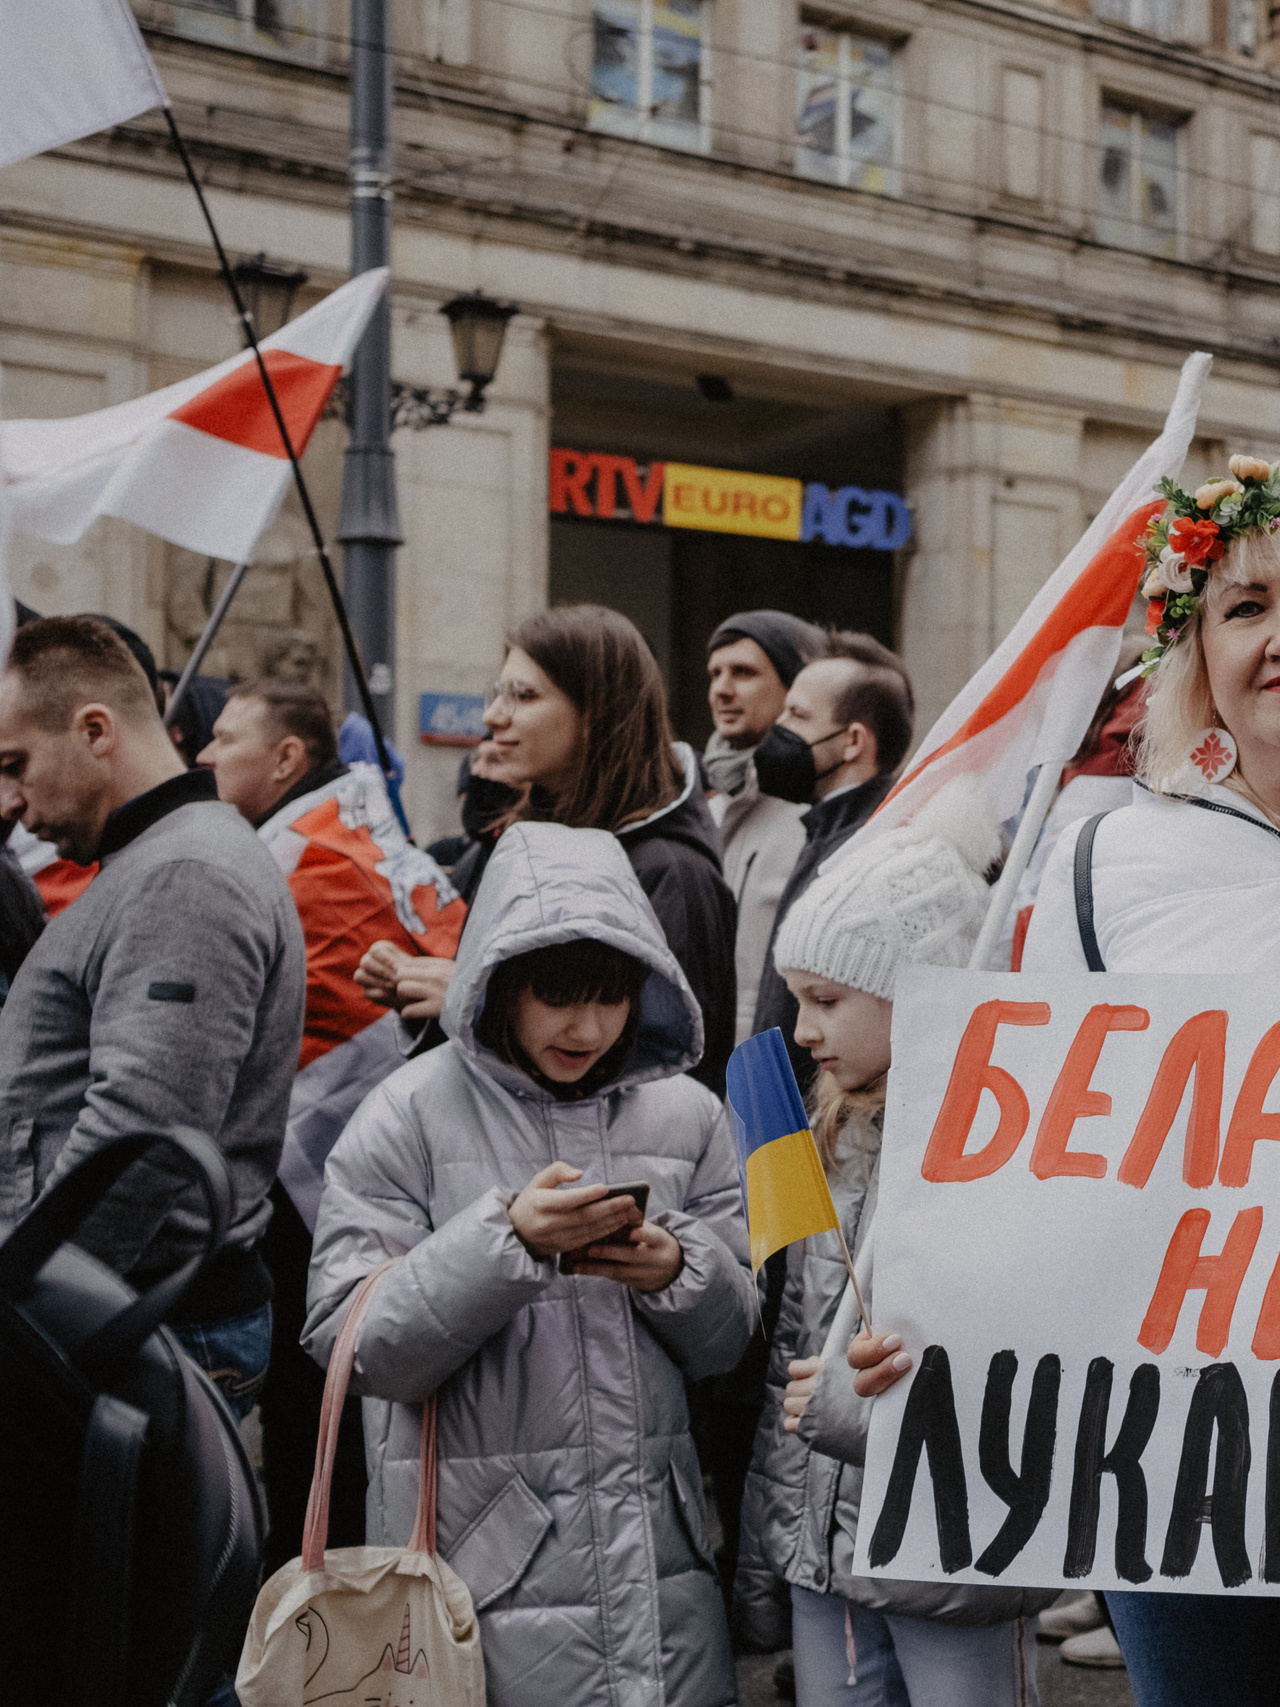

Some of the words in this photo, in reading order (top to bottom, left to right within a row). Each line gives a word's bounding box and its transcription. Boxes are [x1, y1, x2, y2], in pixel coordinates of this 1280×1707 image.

[550, 448, 667, 522] RTV
[672, 483, 792, 523] EURO
[801, 482, 910, 550] AGD
